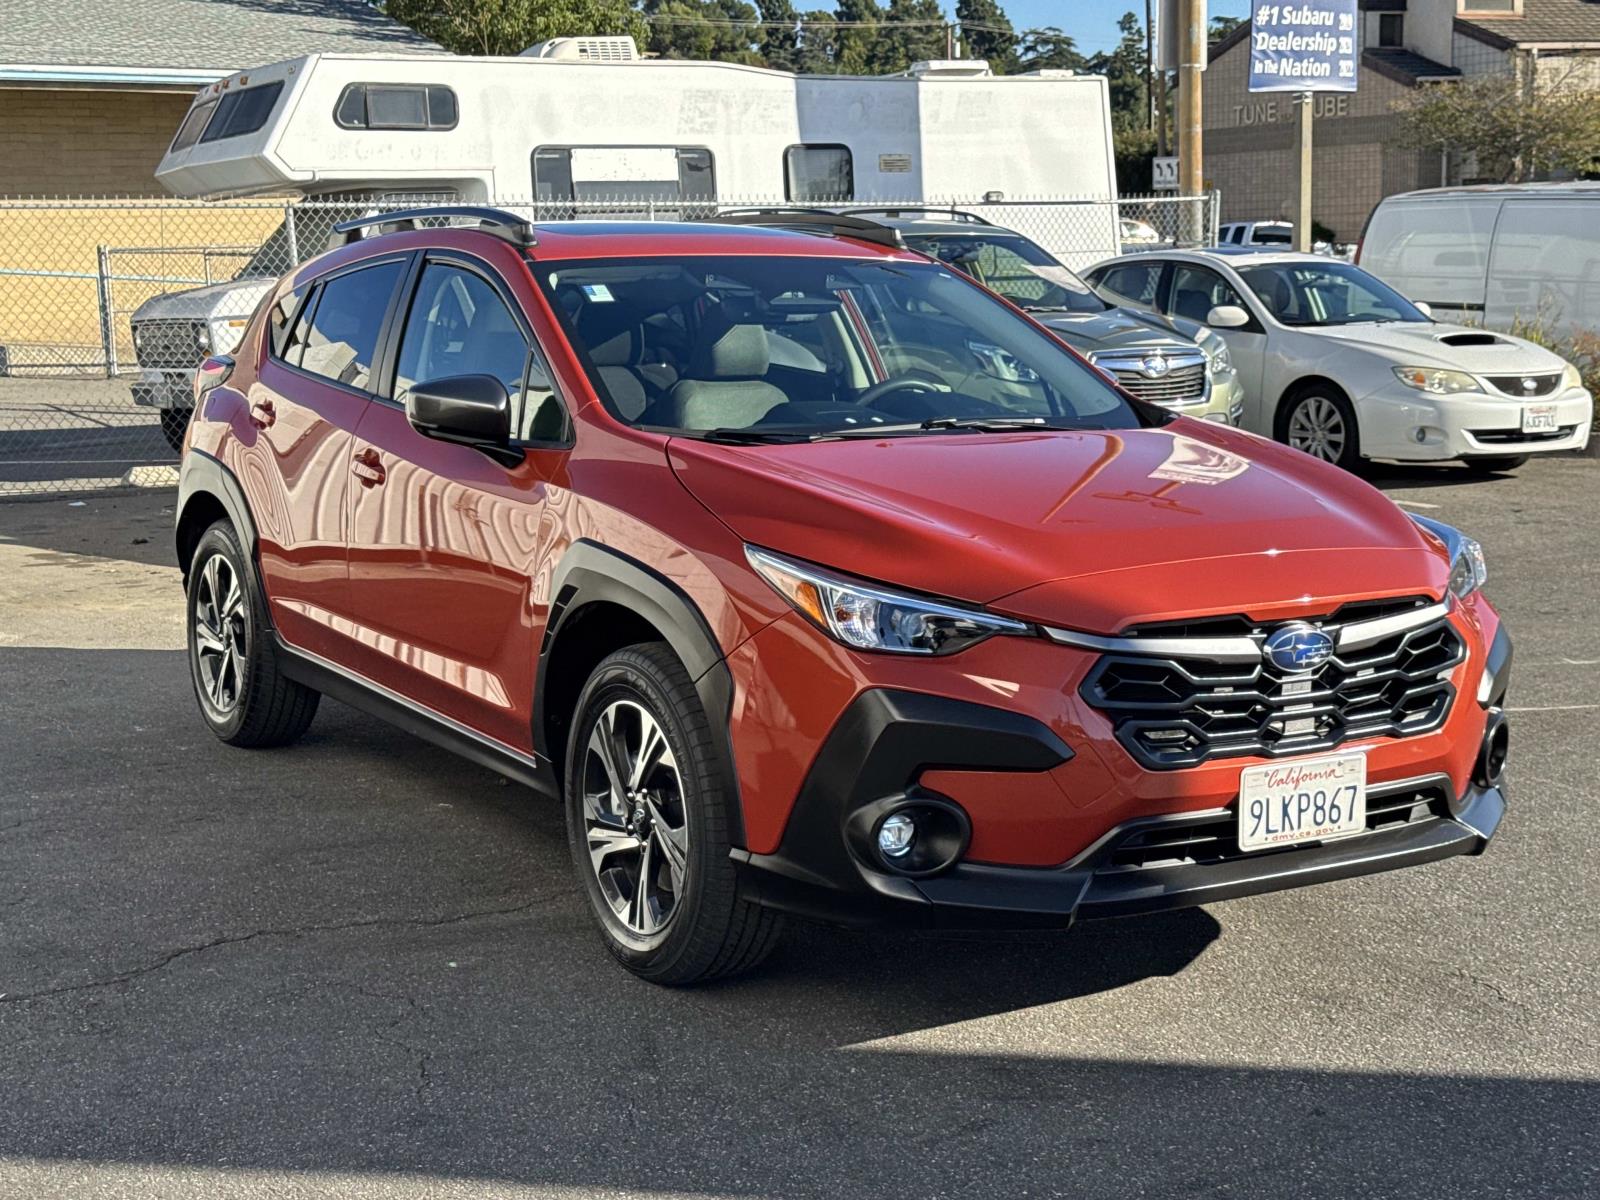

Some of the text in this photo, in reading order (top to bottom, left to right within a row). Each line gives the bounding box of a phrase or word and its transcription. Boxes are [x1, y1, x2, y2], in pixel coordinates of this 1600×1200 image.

[1256, 4, 1280, 26] #1
[1281, 5, 1335, 26] Subaru
[1256, 30, 1337, 56] Dealership
[1254, 60, 1263, 74] In
[1264, 59, 1279, 74] The
[1279, 57, 1331, 77] Nation
[1233, 95, 1349, 126] TUNE UBE
[1268, 765, 1344, 790] California
[1249, 785, 1357, 838] 9LKP867
[1272, 827, 1335, 842] dmv.ca.gov
